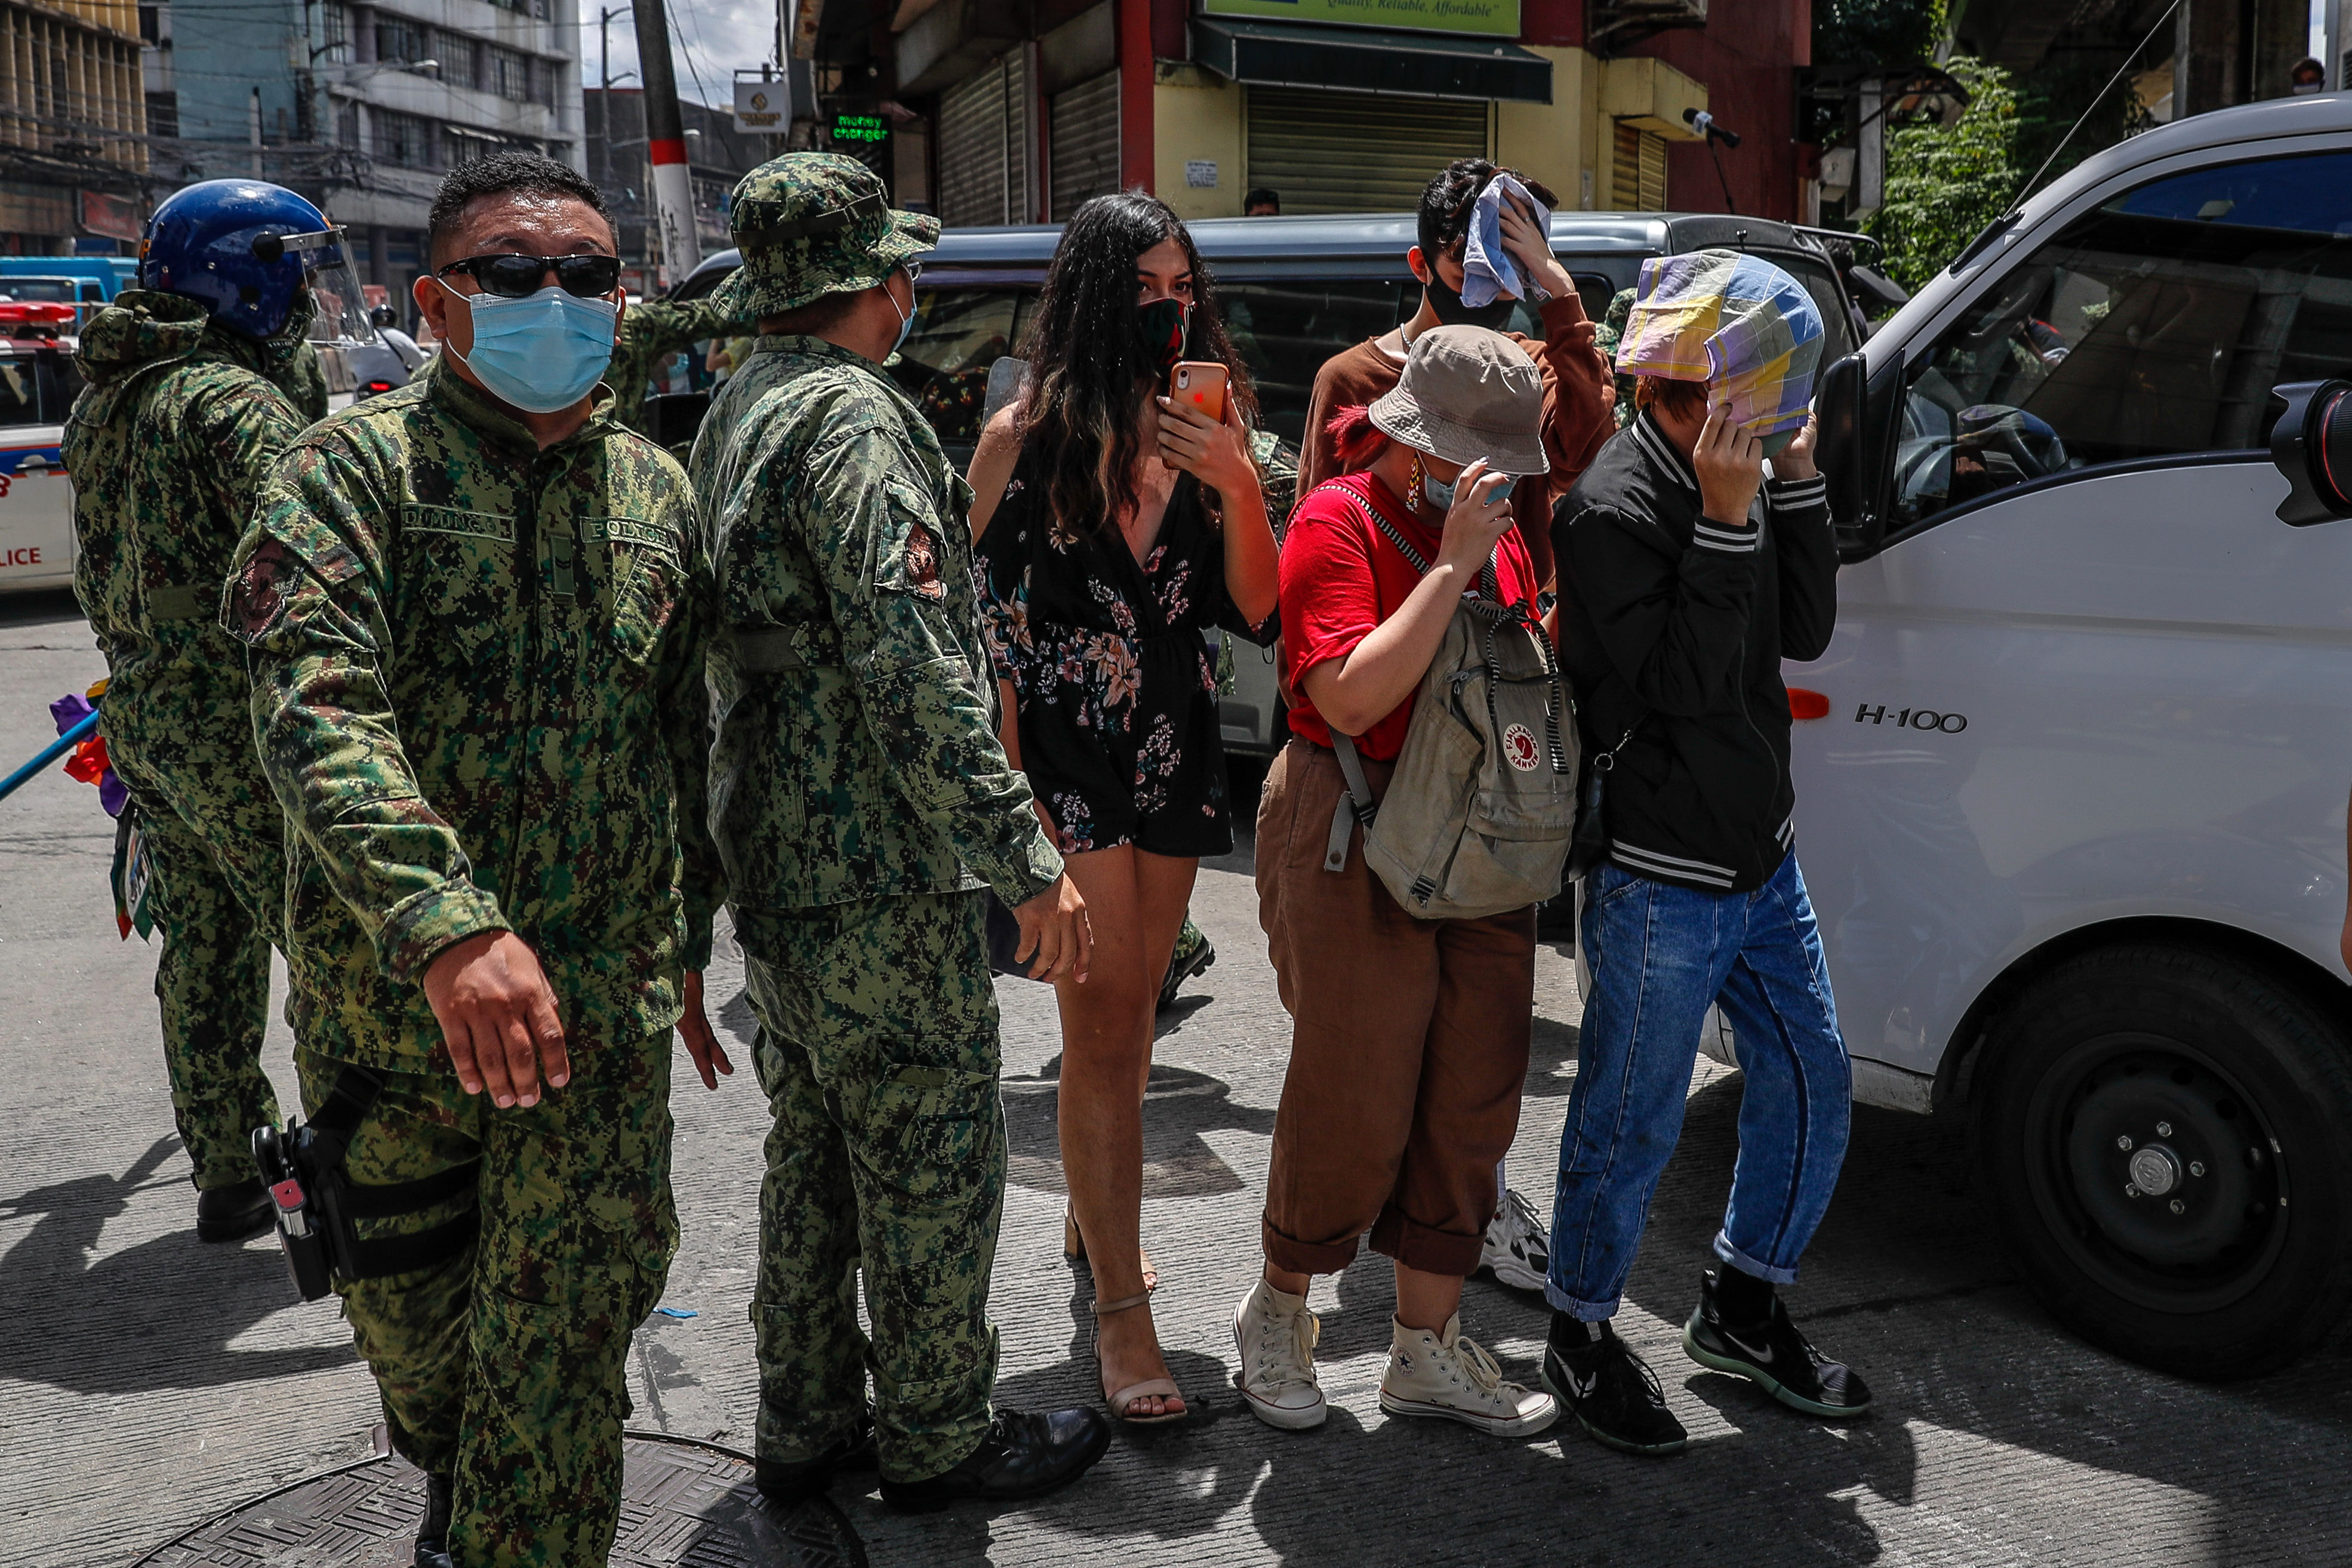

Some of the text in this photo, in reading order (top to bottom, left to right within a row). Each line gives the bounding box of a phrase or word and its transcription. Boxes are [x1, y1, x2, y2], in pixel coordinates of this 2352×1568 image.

[838, 116, 882, 130] money
[833, 127, 888, 142] changer
[589, 520, 671, 548] POLICE
[1854, 703, 1968, 734] H-100
